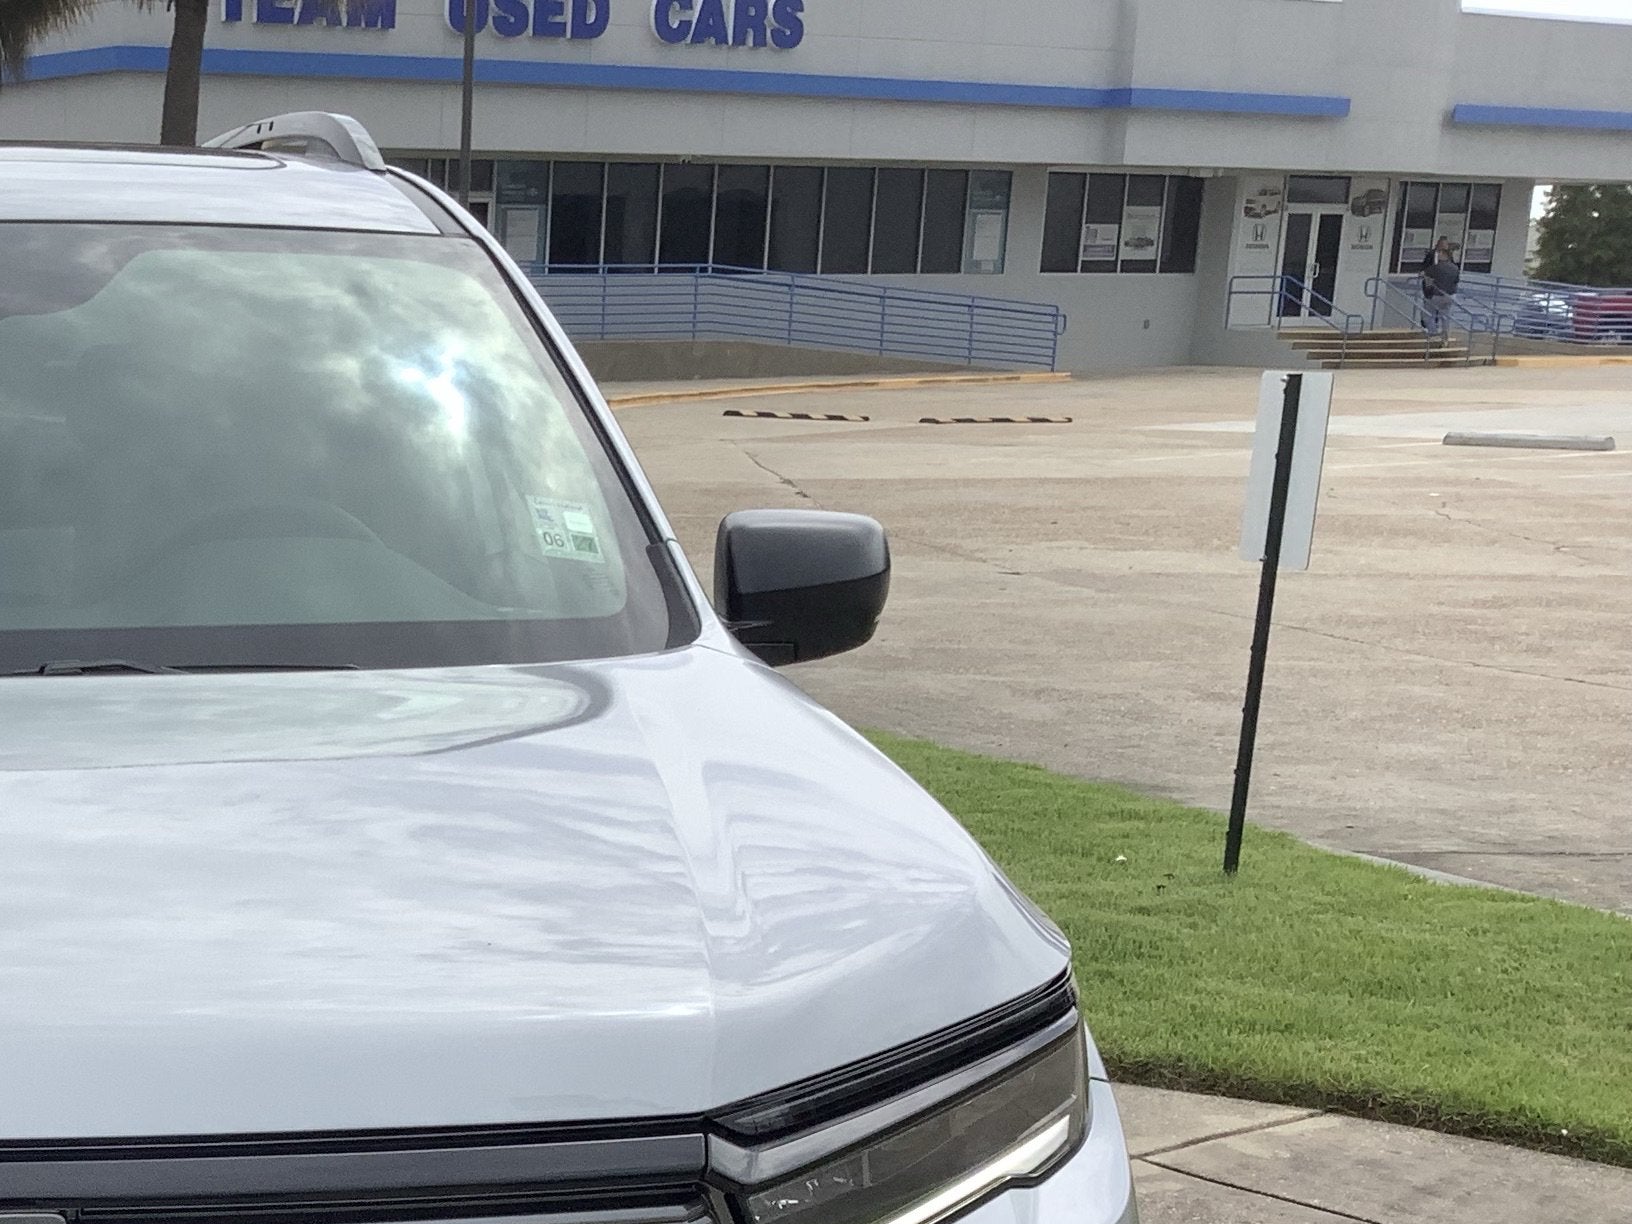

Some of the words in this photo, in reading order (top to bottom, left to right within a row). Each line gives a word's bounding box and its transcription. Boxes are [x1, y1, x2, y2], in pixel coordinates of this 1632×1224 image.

[446, 0, 610, 40] USED
[651, 0, 805, 50] CARS
[543, 531, 565, 548] 06
